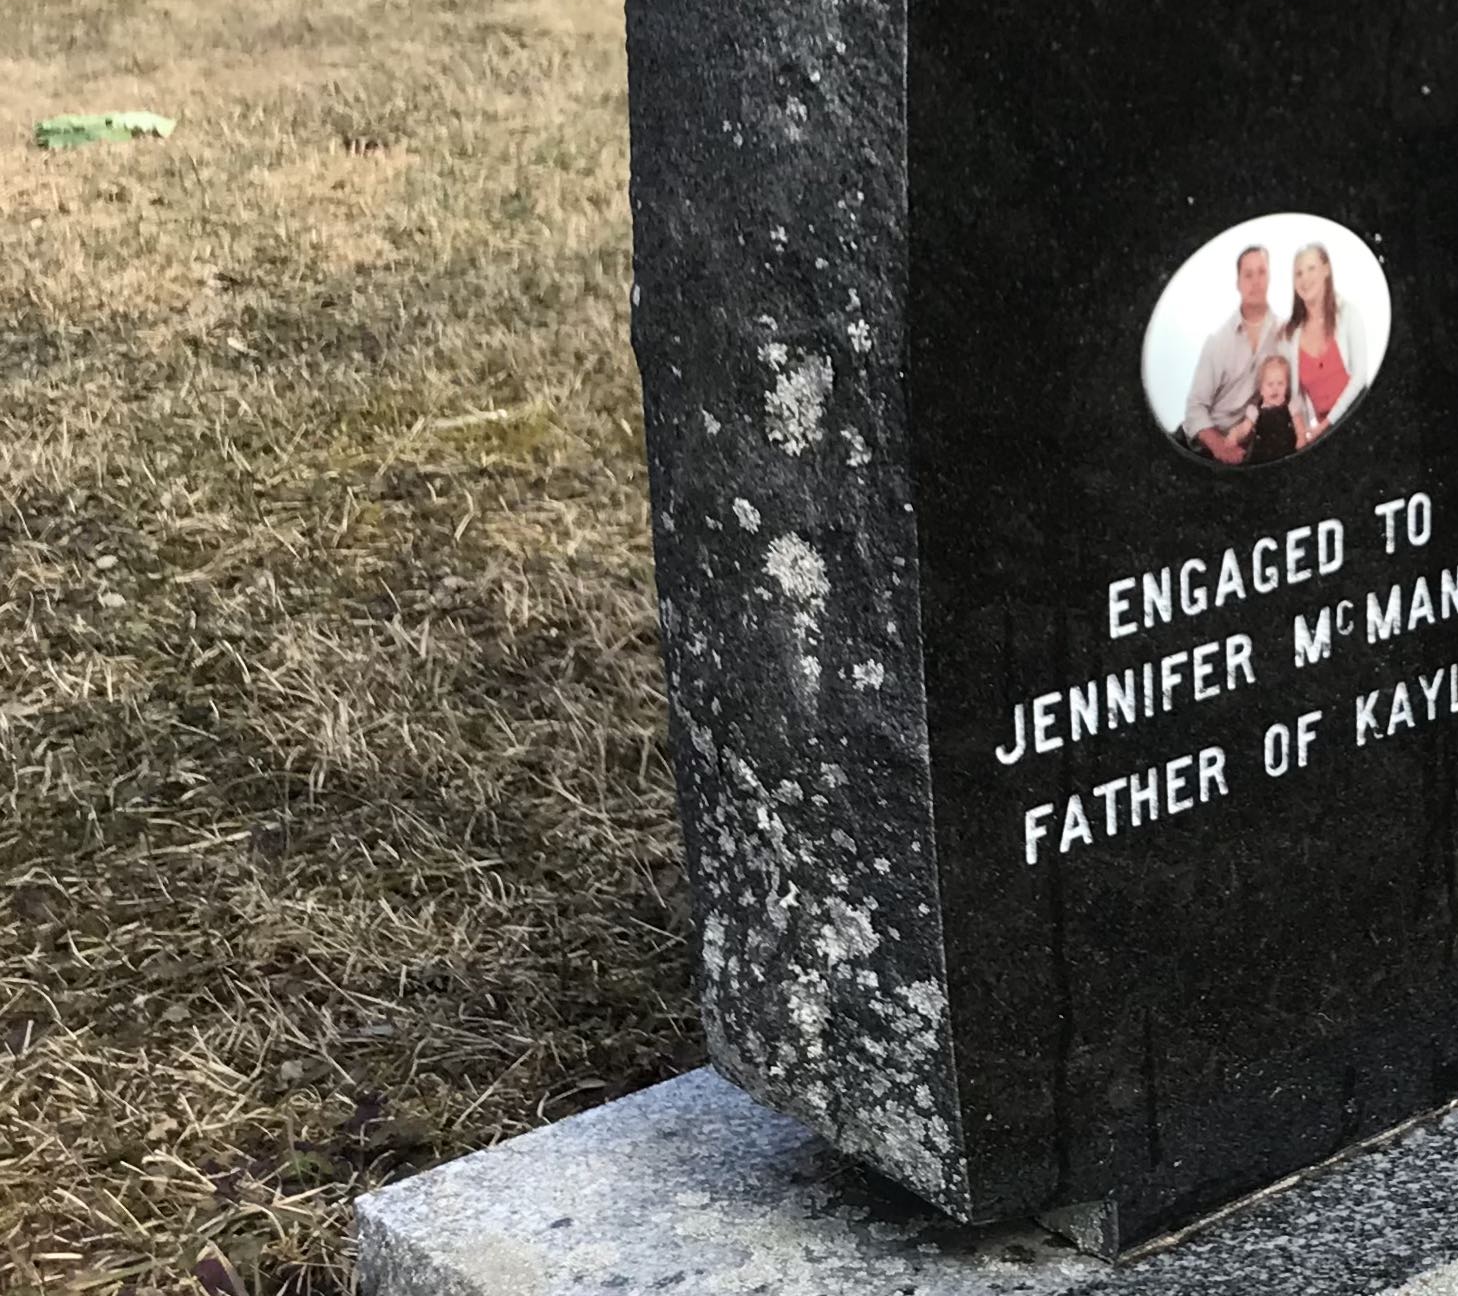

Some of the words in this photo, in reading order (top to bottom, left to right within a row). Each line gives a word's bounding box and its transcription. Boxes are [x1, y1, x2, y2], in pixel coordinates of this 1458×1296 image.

[1106, 516, 1346, 641] ENGAGED
[1372, 490, 1434, 557] TO
[993, 631, 1258, 767] JENNIFER
[1022, 744, 1231, 867] FATHER
[1261, 708, 1325, 779] OF
